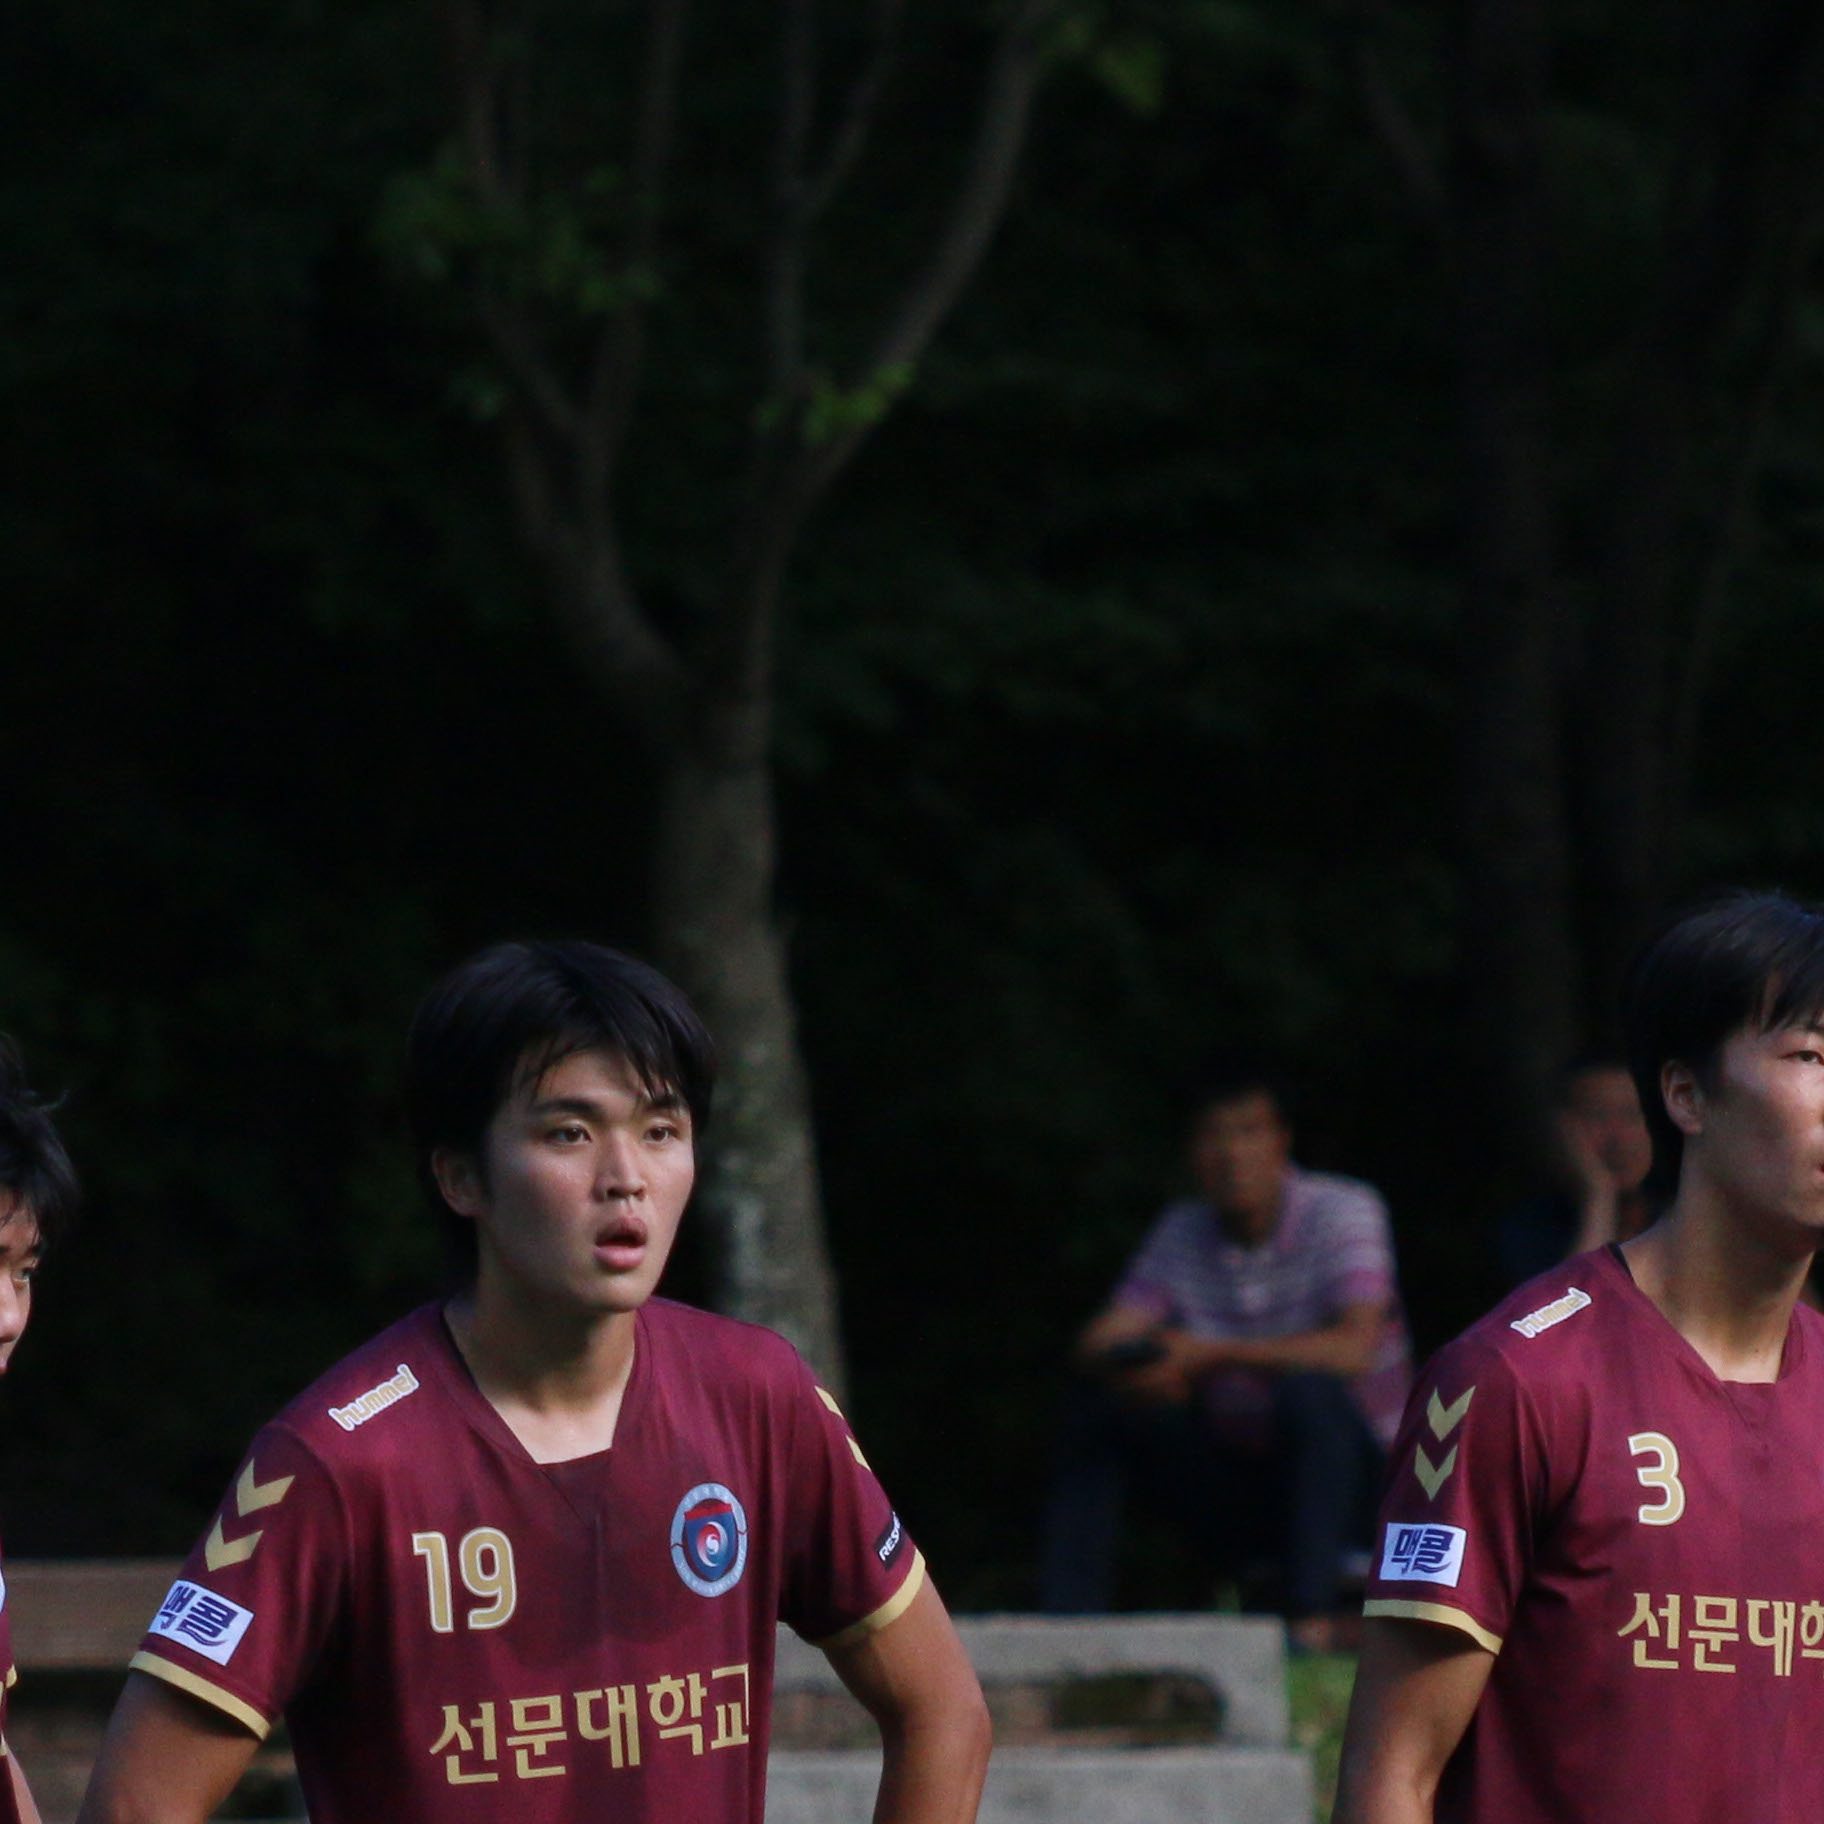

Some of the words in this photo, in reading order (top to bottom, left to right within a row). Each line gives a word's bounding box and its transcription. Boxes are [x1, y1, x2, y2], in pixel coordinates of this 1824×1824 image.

[328, 1363, 419, 1431] hummel
[1628, 1432, 1686, 1526] 3
[412, 1527, 517, 1633] 19
[1391, 1529, 1454, 1574] 맥콜
[430, 1664, 751, 1785] 선문대학교
